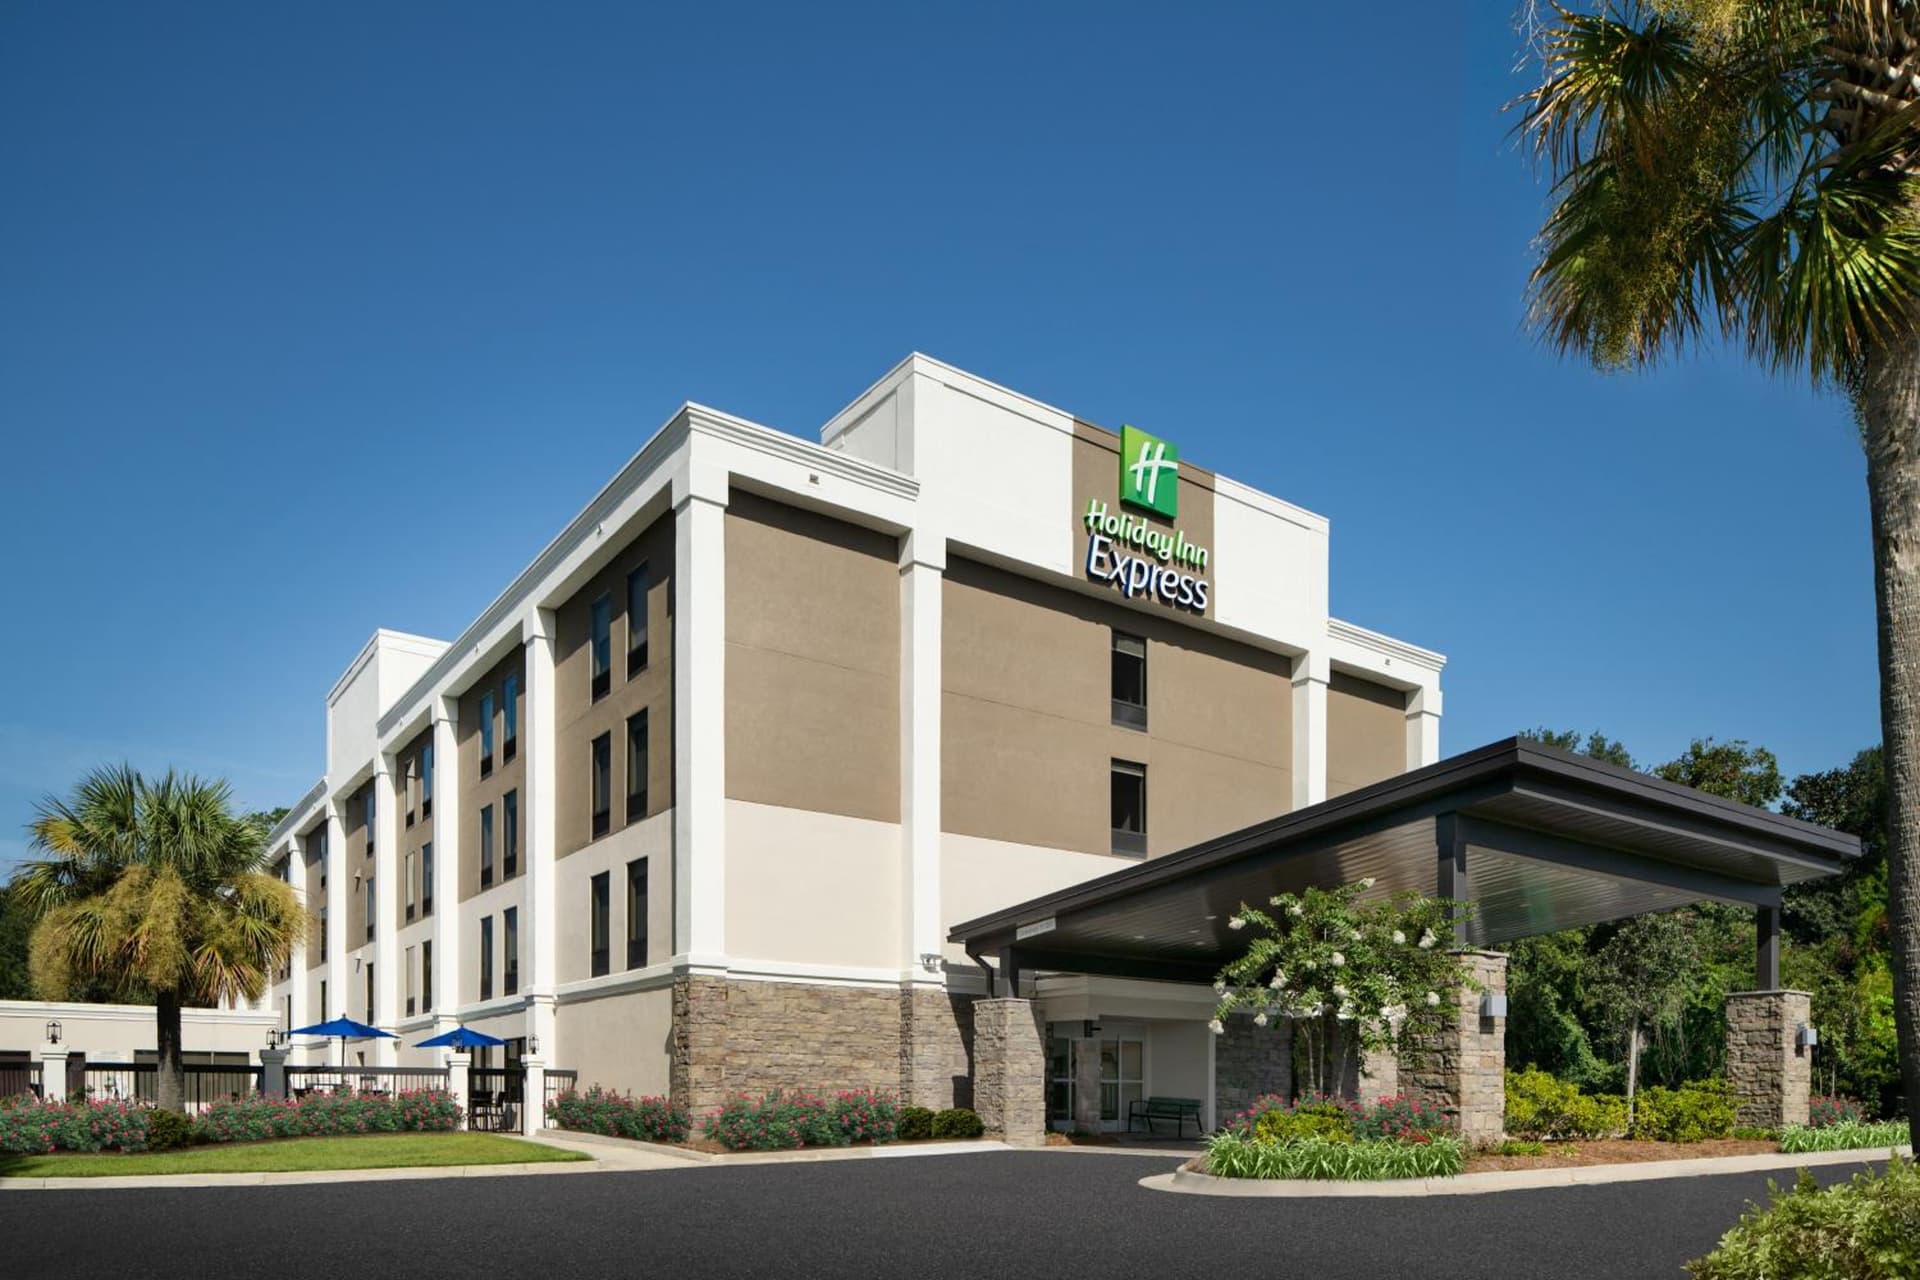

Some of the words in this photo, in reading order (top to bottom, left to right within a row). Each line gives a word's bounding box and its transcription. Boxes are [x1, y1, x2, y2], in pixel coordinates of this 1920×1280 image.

[1087, 499, 1174, 560] Holiday
[1174, 530, 1208, 567] Inn
[1087, 534, 1208, 610] Express
